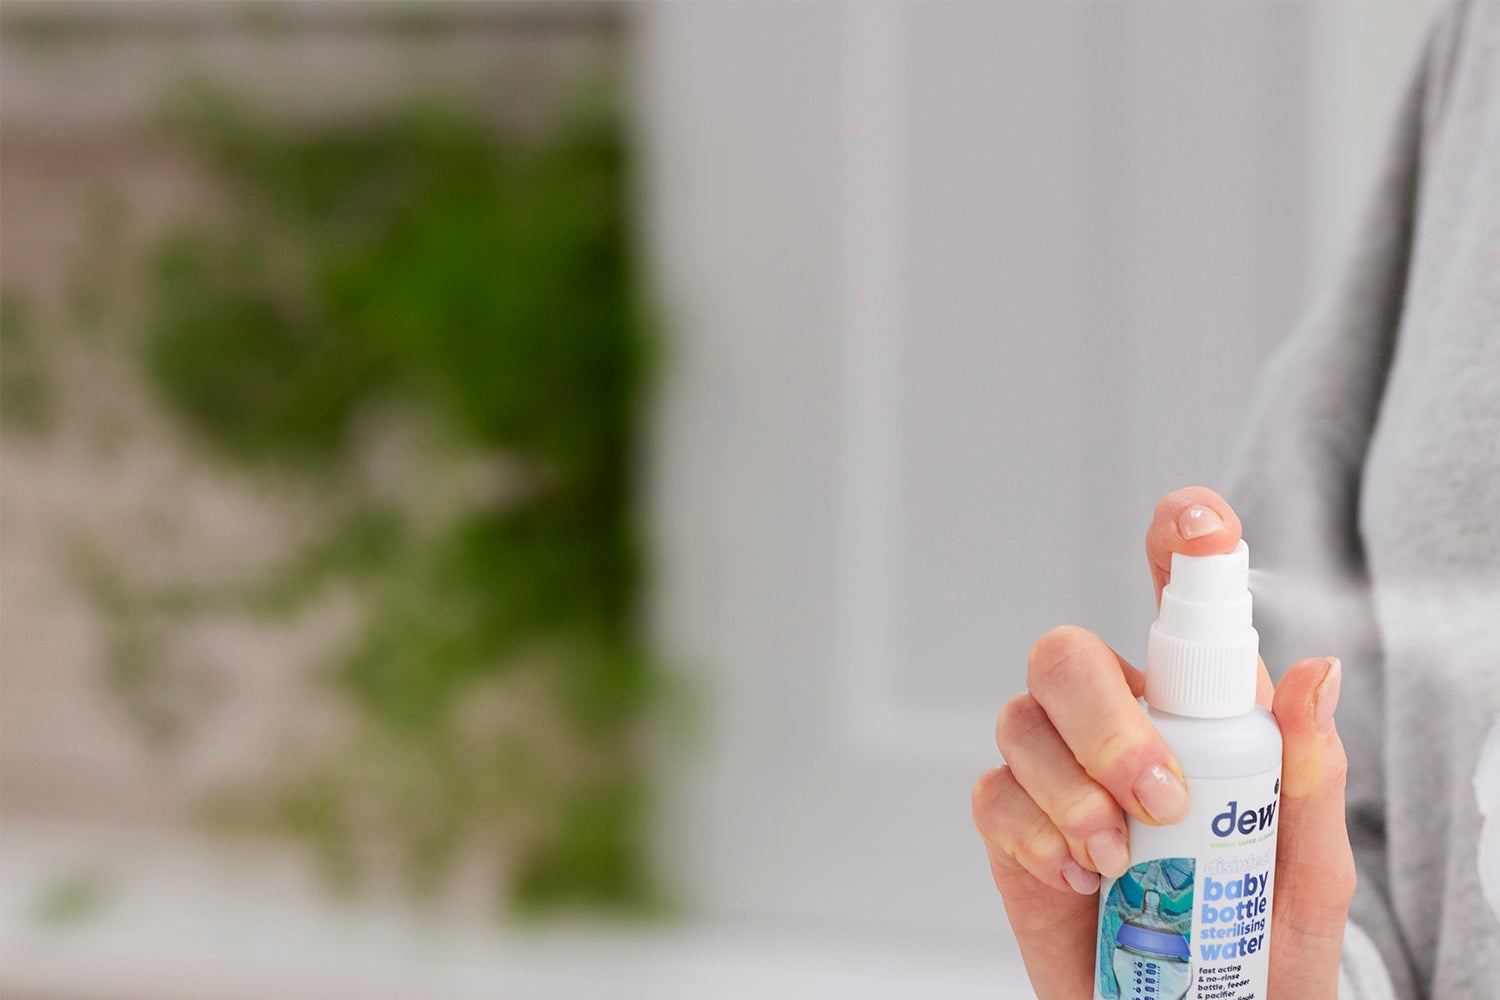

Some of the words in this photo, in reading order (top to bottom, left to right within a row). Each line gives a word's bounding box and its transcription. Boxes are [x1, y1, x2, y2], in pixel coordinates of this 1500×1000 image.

[1211, 800, 1277, 837] dew
[1203, 870, 1268, 901] baby
[1201, 897, 1266, 923] bottle
[1200, 918, 1265, 939] sterilising
[1200, 933, 1264, 960] water
[1206, 973, 1240, 982] no-rinse
[1218, 964, 1241, 973] acting
[1228, 979, 1250, 988] feeder
[1205, 990, 1235, 1000] pacifier
